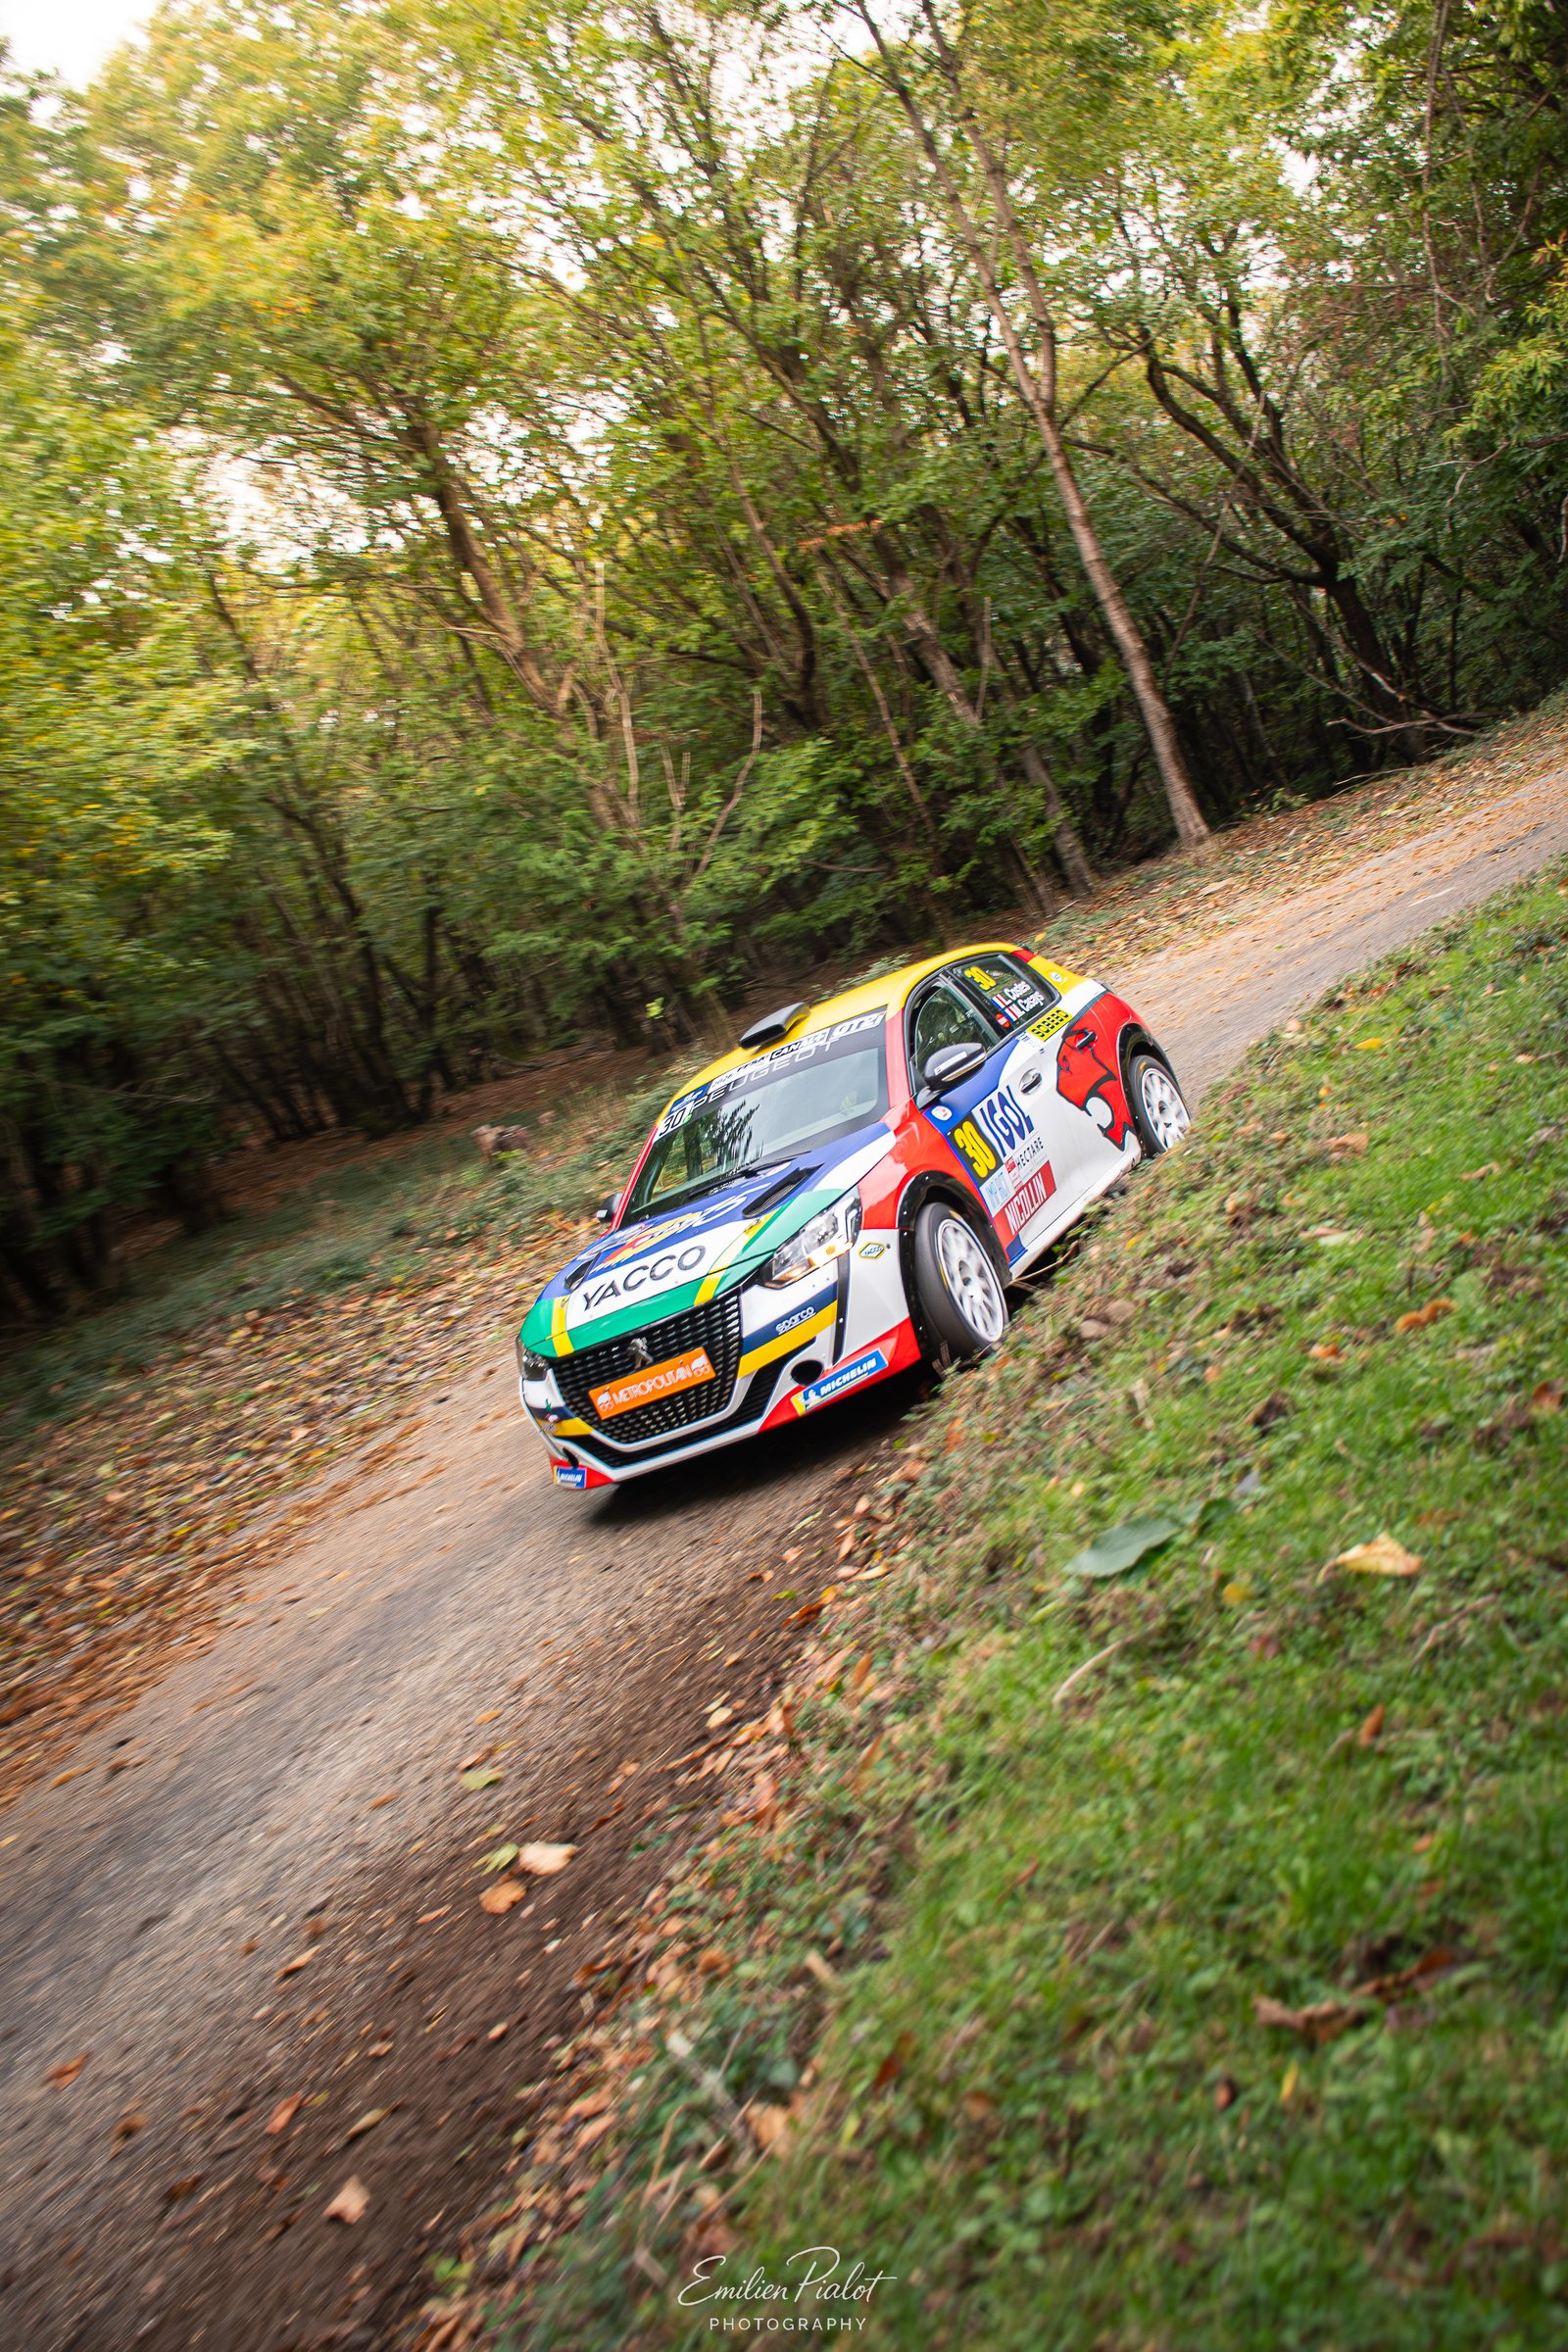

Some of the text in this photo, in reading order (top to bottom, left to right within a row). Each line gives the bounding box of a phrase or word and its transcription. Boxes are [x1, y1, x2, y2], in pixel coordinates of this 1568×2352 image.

[964, 966, 997, 991] 30
[689, 1037, 841, 1114] PEUGEOT
[660, 1107, 686, 1137] 30
[979, 1085, 1035, 1158] IGOL
[954, 1120, 997, 1178] 30
[1016, 1137, 1045, 1170] HECTARE
[1004, 1171, 1047, 1236] NICOLLIN
[583, 1246, 707, 1311] YACCO
[775, 1306, 815, 1334] sparco
[612, 1365, 693, 1404] METROPOLITAN
[819, 1357, 877, 1396] MICHELIN
